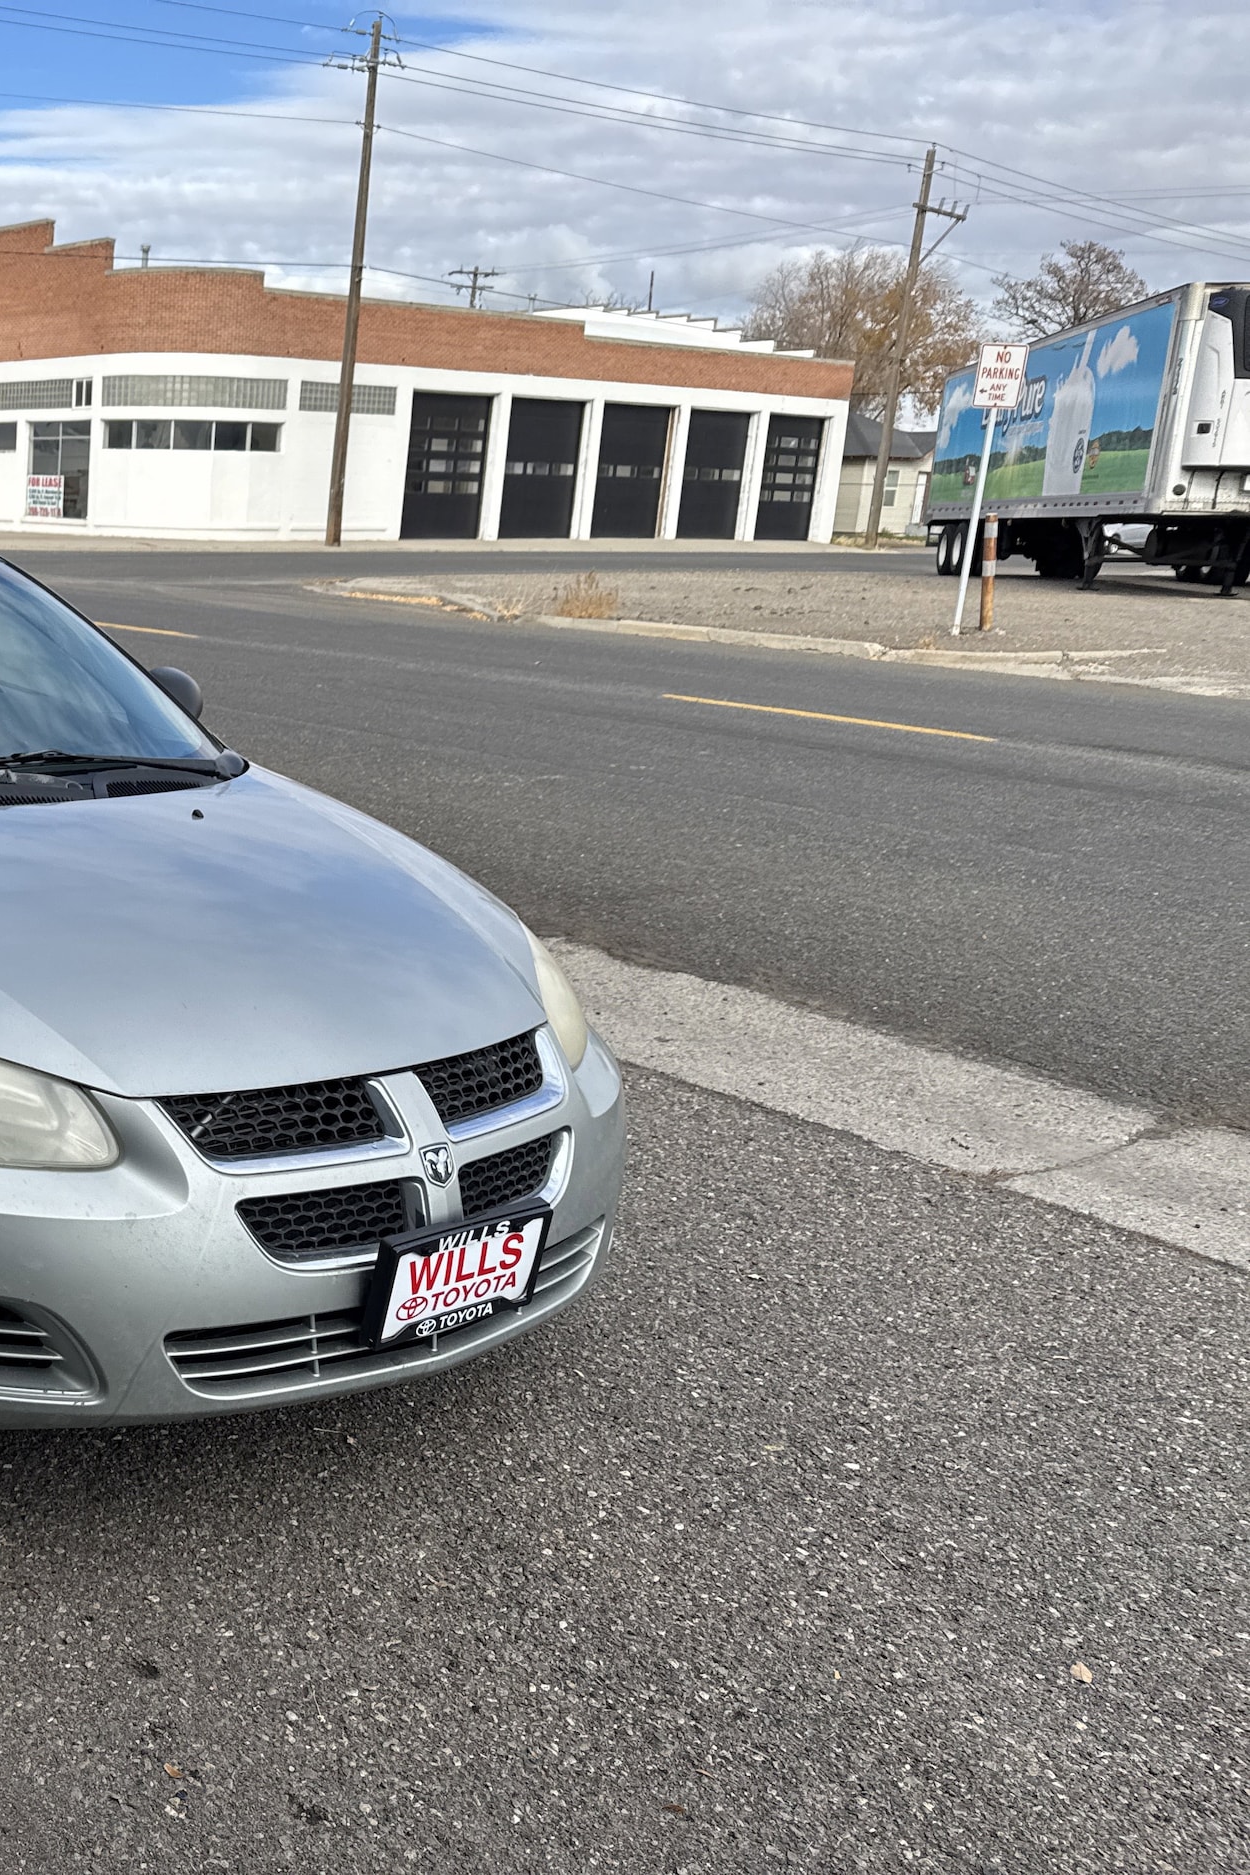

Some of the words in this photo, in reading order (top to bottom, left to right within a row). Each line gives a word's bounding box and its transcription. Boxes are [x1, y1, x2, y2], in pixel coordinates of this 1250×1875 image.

[996, 351, 1012, 363] NO
[981, 367, 1020, 380] PARKING
[989, 383, 1008, 392] ANY
[988, 393, 1006, 401] TIME
[28, 477, 40, 487] FOR
[41, 477, 62, 488] LEASE
[439, 1220, 511, 1252] WILLS
[409, 1233, 525, 1295] WILLS
[431, 1271, 517, 1311] TOYOTA
[439, 1302, 494, 1329] TOYOTA
